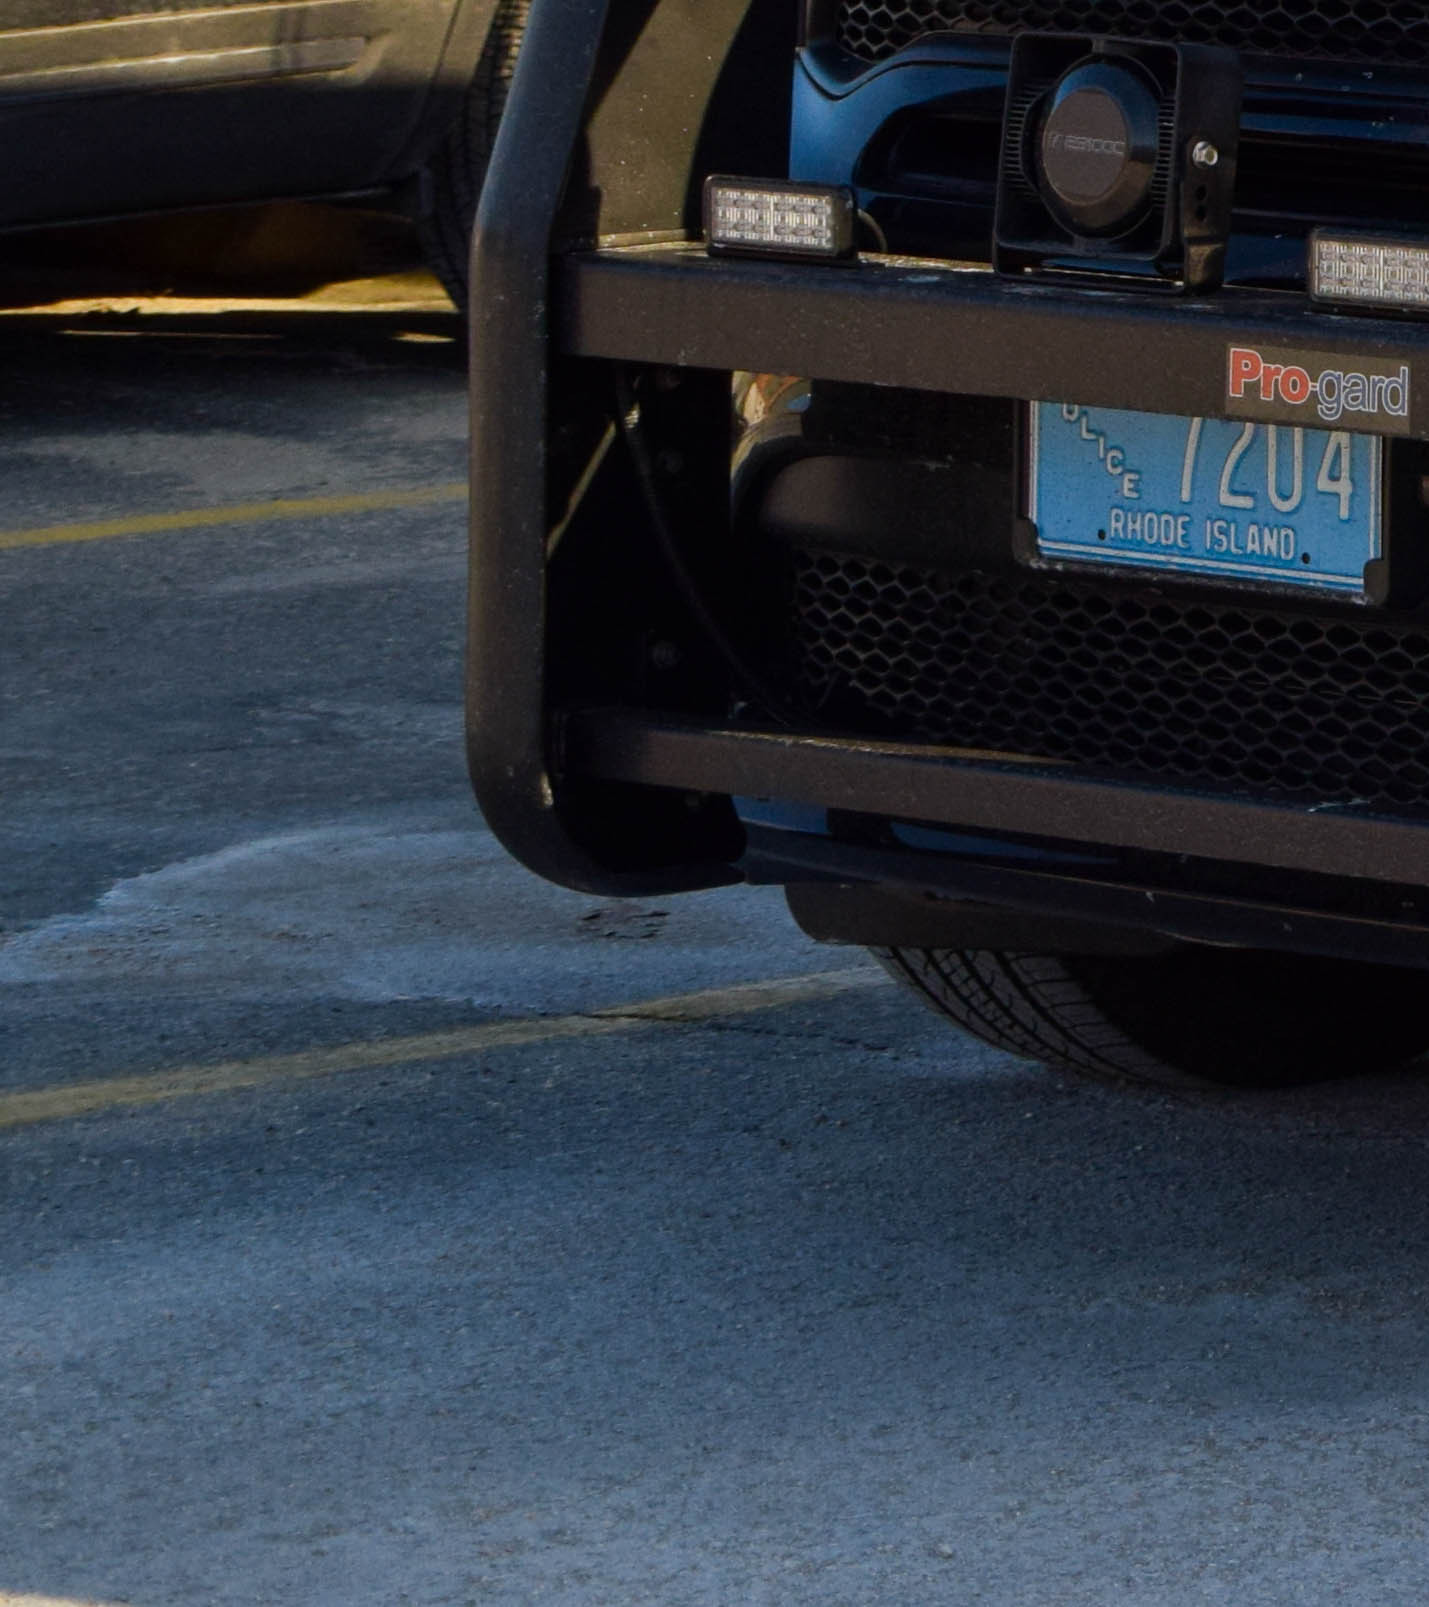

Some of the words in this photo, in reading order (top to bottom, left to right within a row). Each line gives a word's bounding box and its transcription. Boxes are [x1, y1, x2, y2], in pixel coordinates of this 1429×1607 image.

[1229, 347, 1410, 421] Pro-gard
[1110, 507, 1190, 547] RHODE
[1205, 519, 1296, 562] ISLAND
